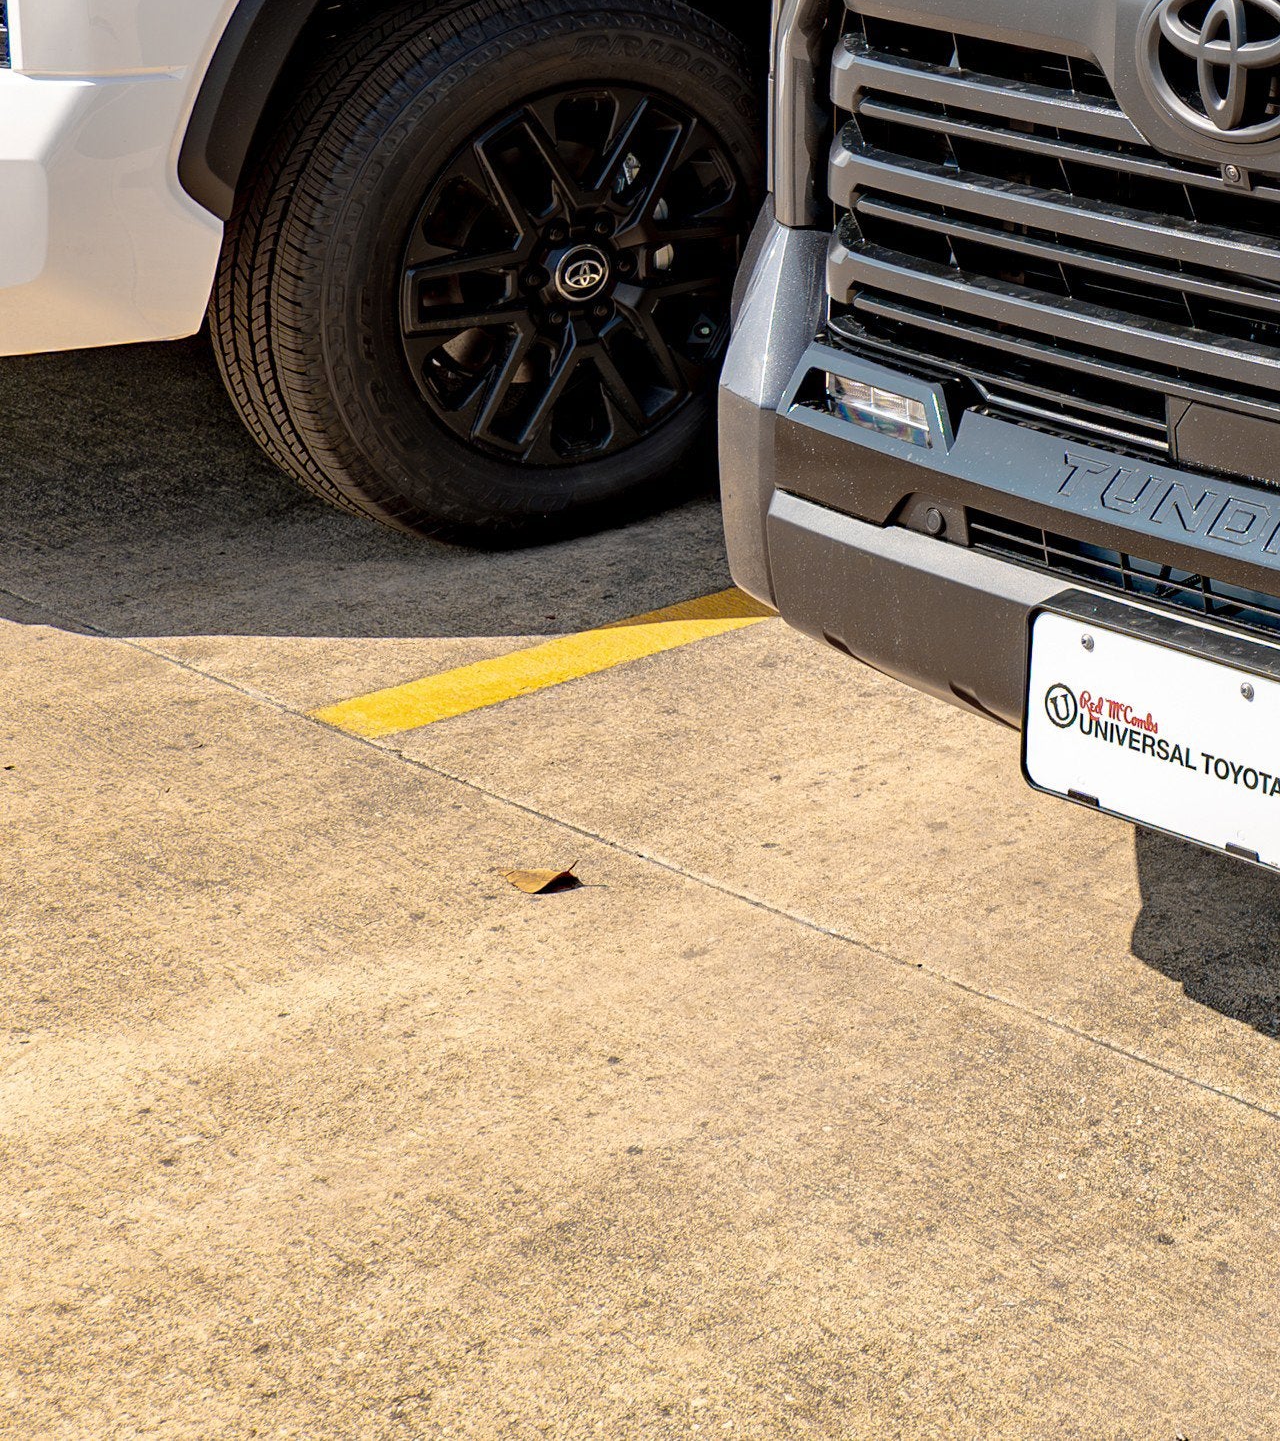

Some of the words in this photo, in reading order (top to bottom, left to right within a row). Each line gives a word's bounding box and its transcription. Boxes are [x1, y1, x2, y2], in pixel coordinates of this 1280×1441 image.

[1080, 690, 1103, 718] Red
[1105, 699, 1159, 734] McCombs
[1079, 712, 1197, 771] UNIVERSAL
